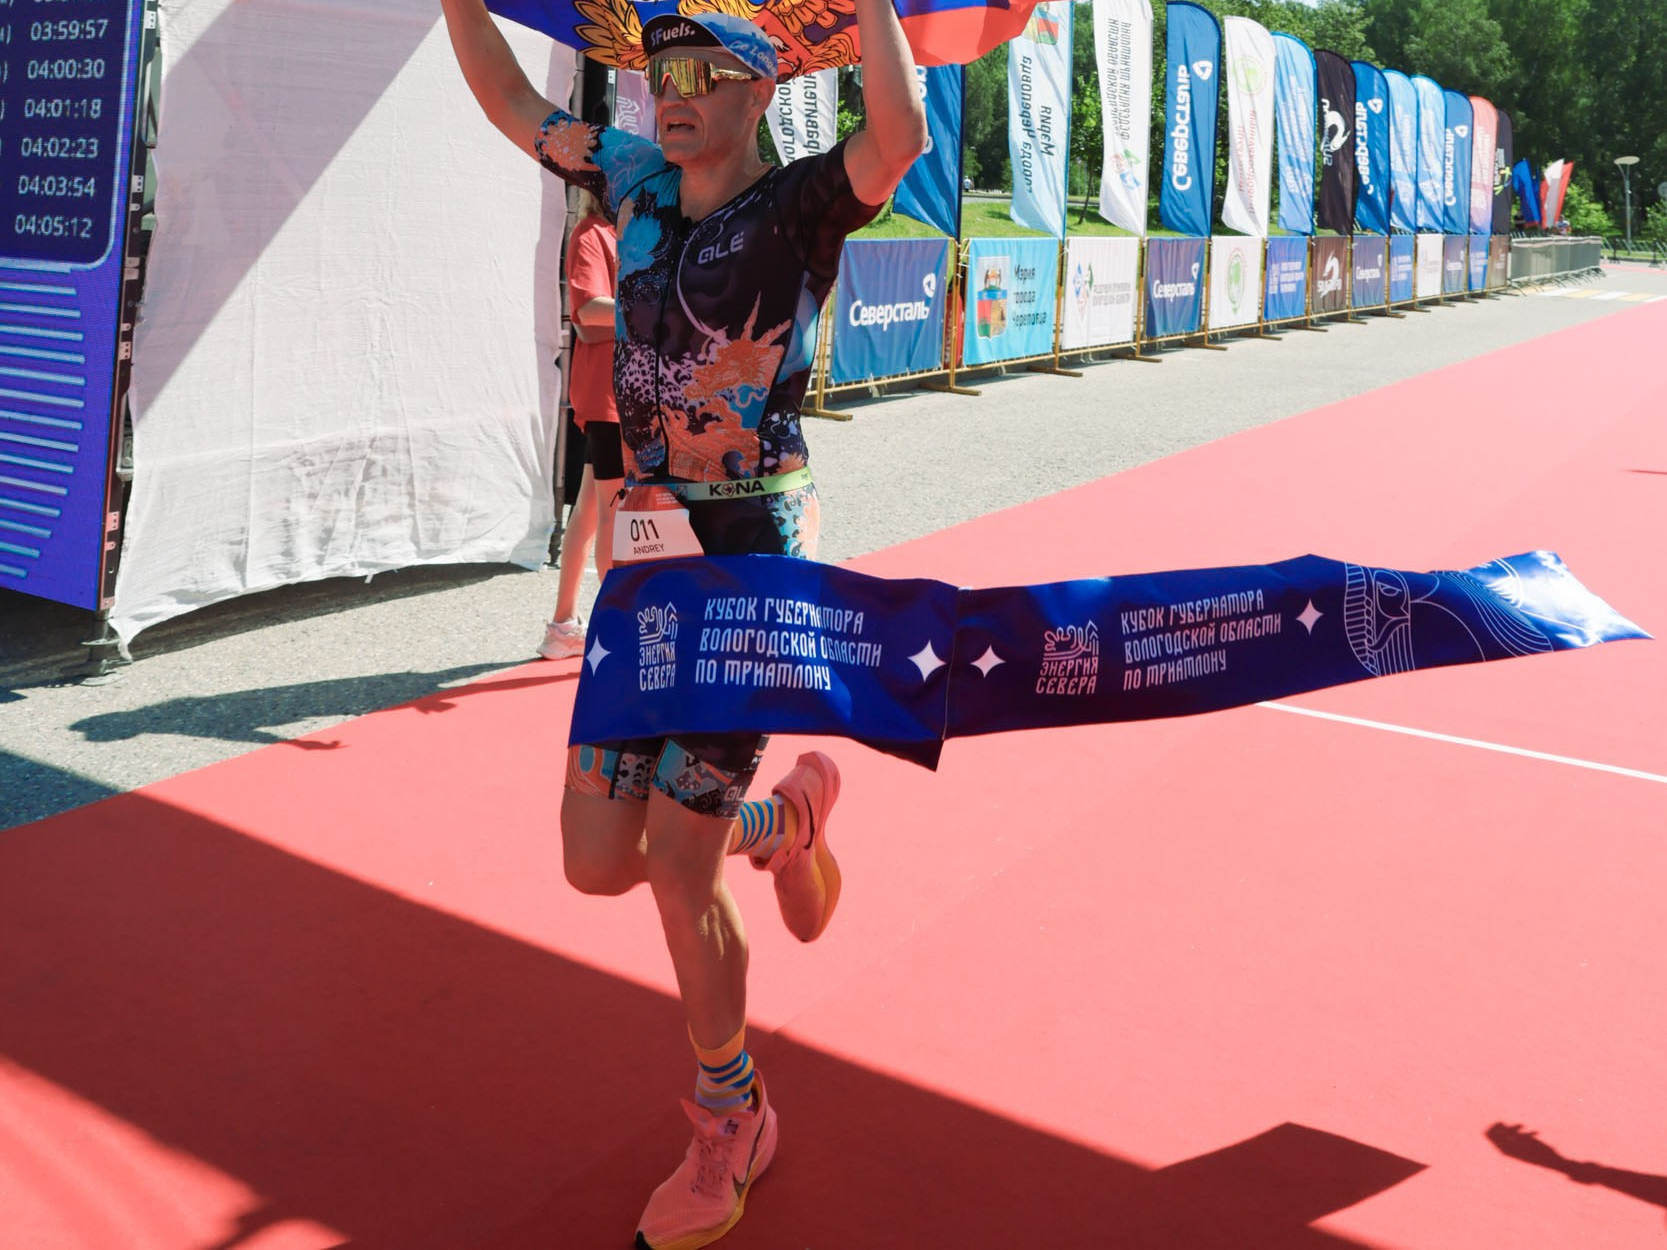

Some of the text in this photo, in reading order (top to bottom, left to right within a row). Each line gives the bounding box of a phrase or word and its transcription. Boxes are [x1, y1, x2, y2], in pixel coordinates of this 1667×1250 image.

[30, 19, 109, 41] 03:59:57
[650, 21, 696, 47] SFuels.
[27, 59, 105, 79] 04:00:30
[24, 98, 102, 119] 04:01:18
[21, 137, 99, 159] 04:02:23
[18, 175, 96, 198] 04:03:54
[14, 214, 93, 239] 04:05:12
[1153, 279, 1195, 303] Северсталь
[849, 299, 930, 332] Северсталь
[630, 519, 660, 543] 011
[633, 544, 665, 556] ANDREY
[704, 597, 864, 635] КУБОК ГУБЕРНАТОРА
[1120, 589, 1264, 635] КУБОК ГУБЕРНАТОРА
[699, 627, 882, 668] ВОЛОГОДСКОЙ ОБЛАСТИ
[1124, 613, 1282, 665] ВОЛОГОДСКОЙ ОБЛАСТИ
[639, 663, 676, 692] СЕВЕРА
[695, 659, 832, 691] ПО ТРИАТЛОНУ
[1039, 656, 1099, 678] ЭНЕРГИЯ
[1123, 650, 1227, 692] ПО ТРИАТЛОНУ
[1035, 675, 1097, 695] СЕВЕРА
